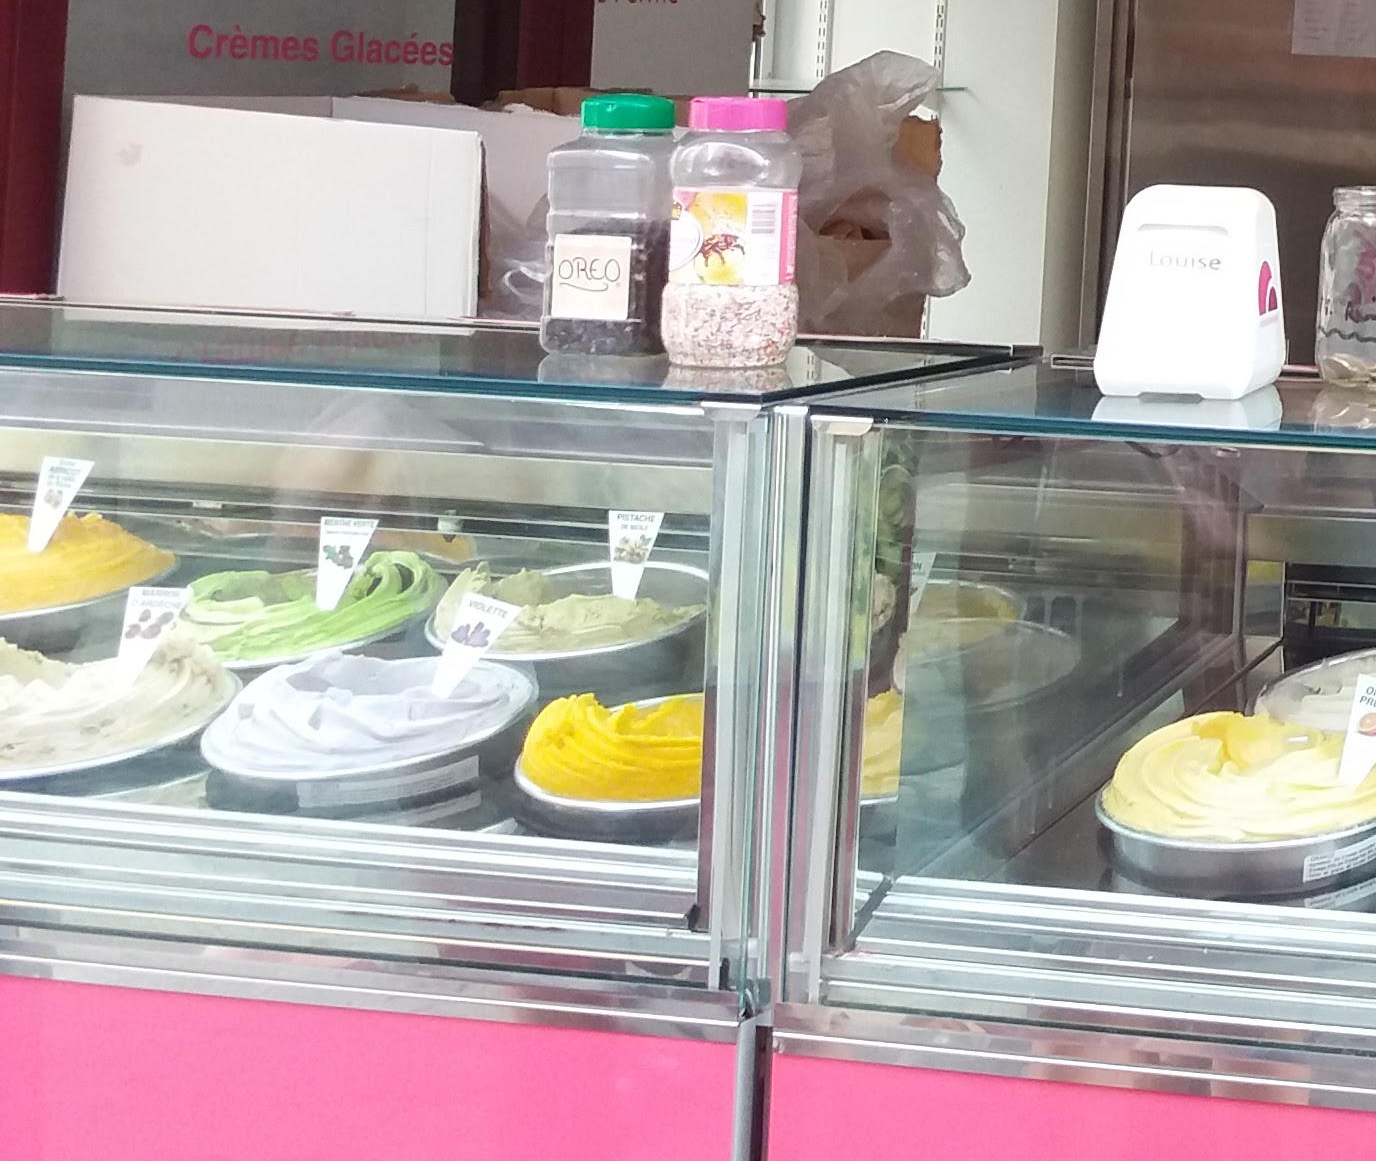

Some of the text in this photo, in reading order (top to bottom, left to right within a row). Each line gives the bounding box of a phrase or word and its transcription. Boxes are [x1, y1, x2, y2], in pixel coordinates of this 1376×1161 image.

[187, 23, 455, 67] Crèmes Glacées
[558, 256, 621, 284] OREO
[1148, 248, 1222, 271] Louise
[616, 513, 656, 523] PISTACHE
[468, 600, 509, 619] VIOLETTE
